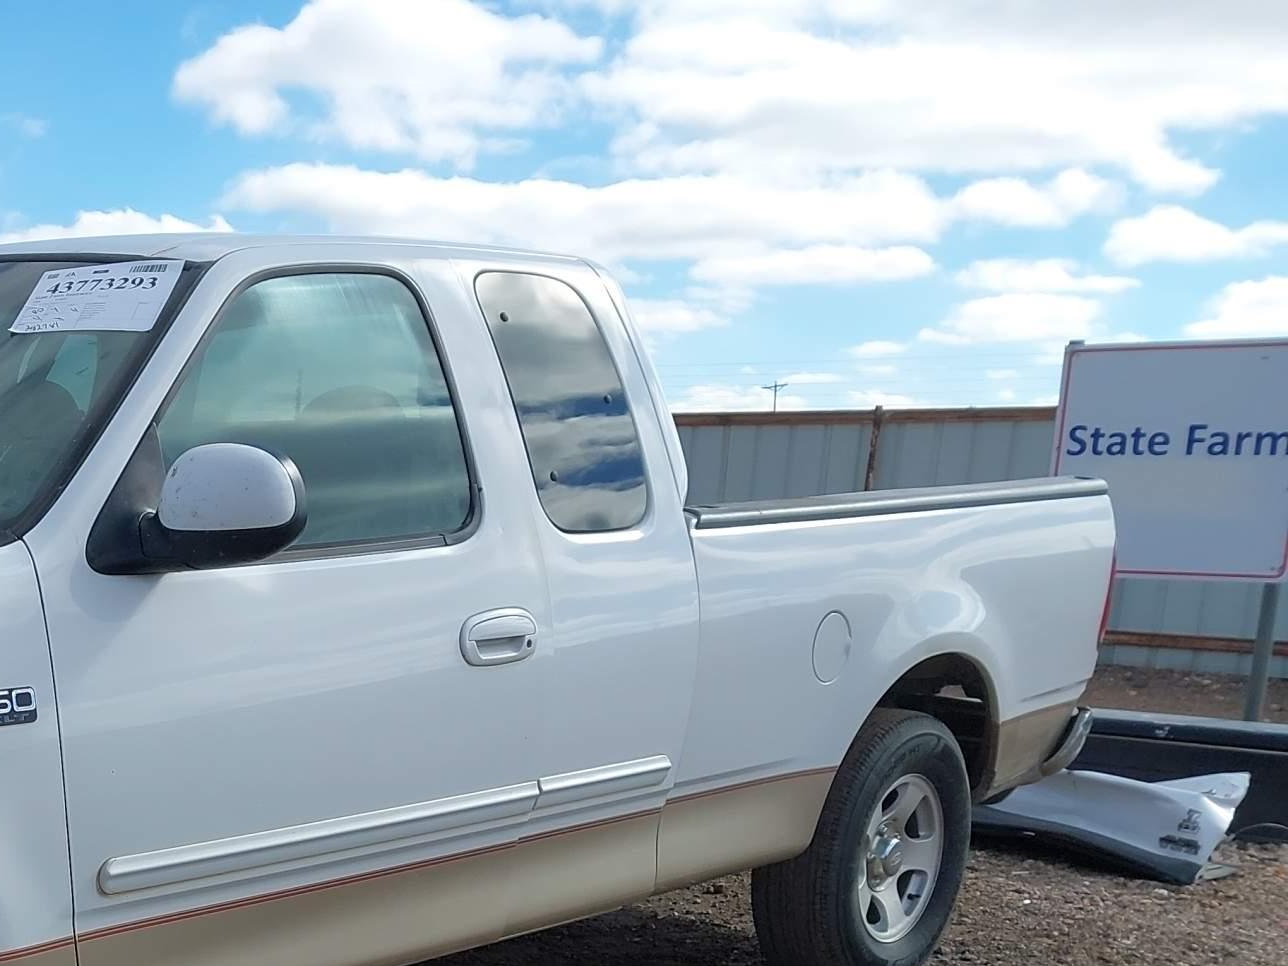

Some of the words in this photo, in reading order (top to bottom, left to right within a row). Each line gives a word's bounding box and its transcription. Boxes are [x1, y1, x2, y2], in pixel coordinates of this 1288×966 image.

[46, 276, 158, 294] 43773293
[1066, 424, 1170, 456] State
[1185, 424, 1288, 456] Farm
